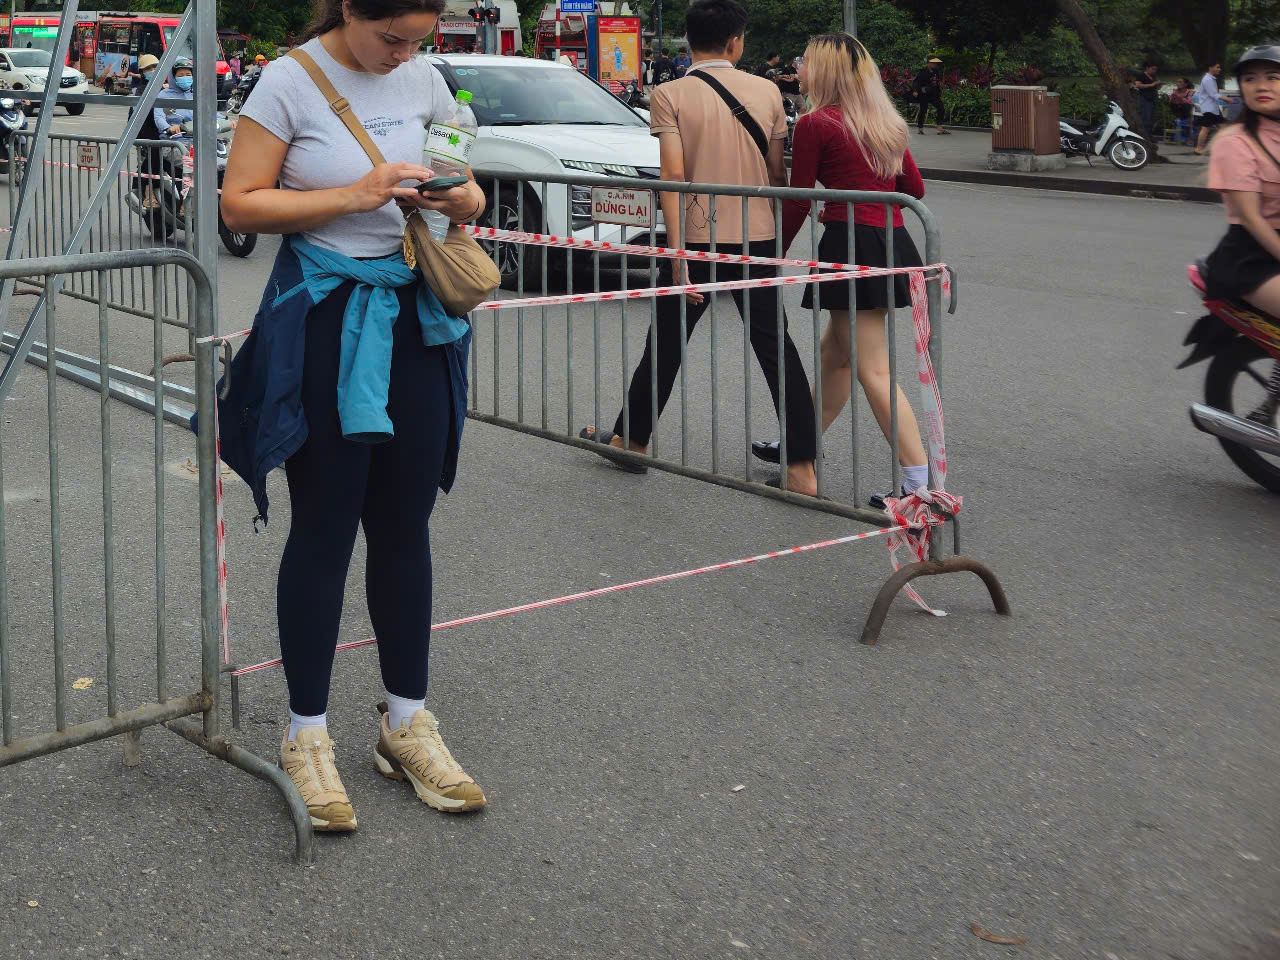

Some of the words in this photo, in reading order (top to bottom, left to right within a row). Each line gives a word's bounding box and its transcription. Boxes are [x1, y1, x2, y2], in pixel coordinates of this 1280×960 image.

[80, 155, 94, 163] STOP
[595, 200, 626, 215] DỪNG
[628, 204, 647, 219] LẠI
